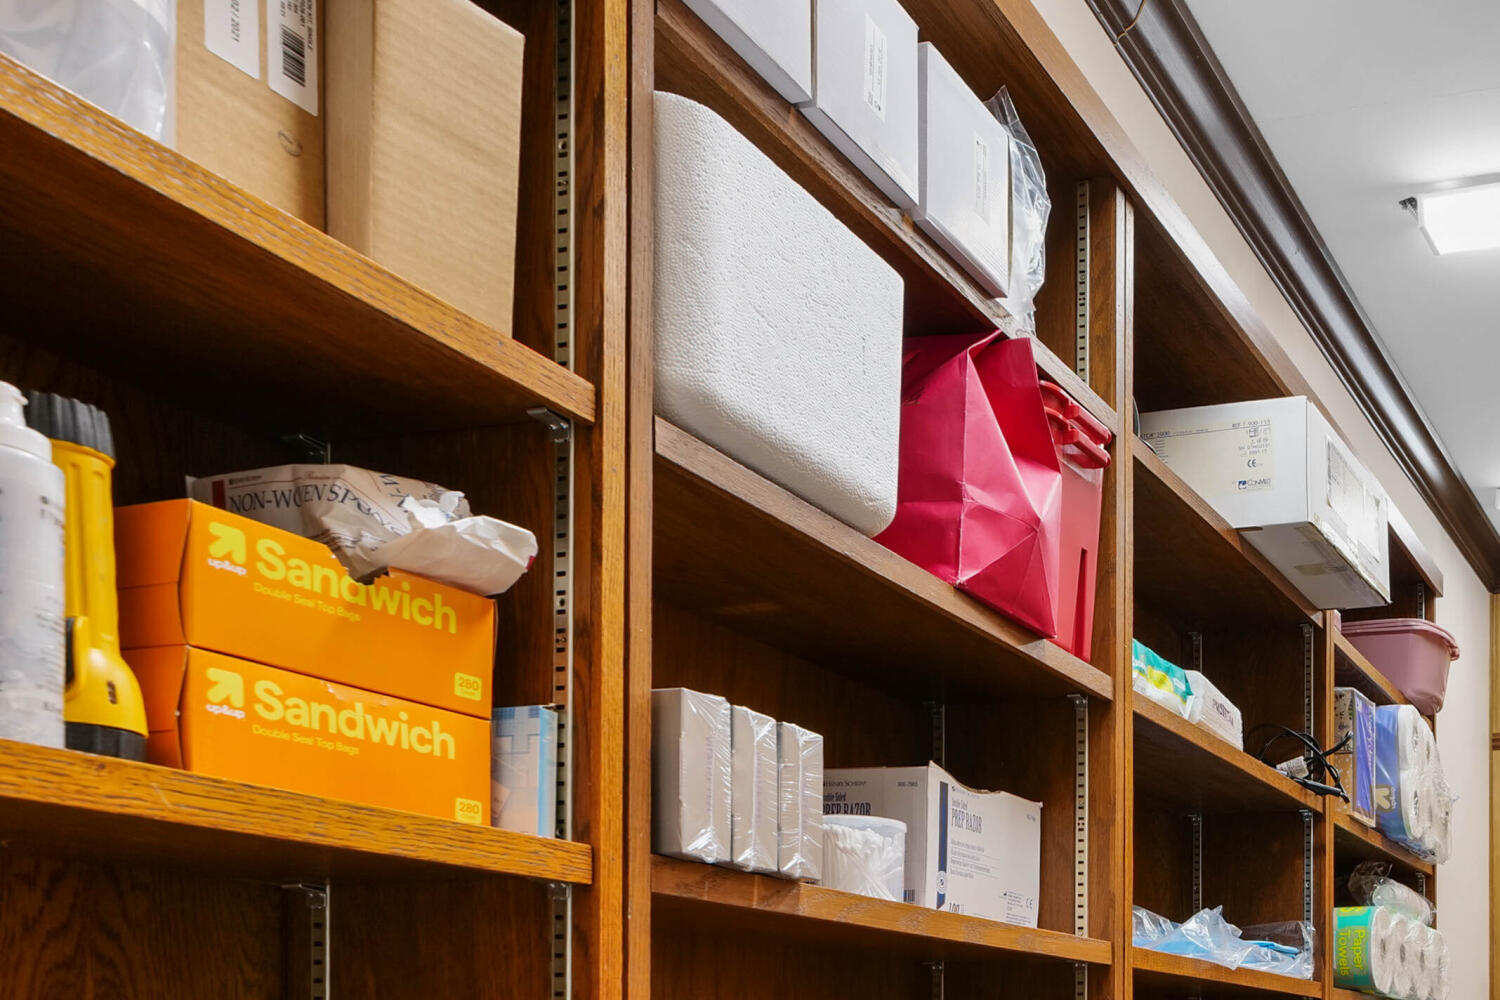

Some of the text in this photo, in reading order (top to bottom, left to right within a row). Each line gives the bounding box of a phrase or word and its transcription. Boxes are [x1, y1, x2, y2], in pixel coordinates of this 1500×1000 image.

[229, 484, 325, 512] NON-WOEN
[253, 582, 292, 602] Double
[317, 599, 336, 616] Top
[256, 538, 457, 634] Sandwich
[458, 676, 479, 691] 280
[254, 679, 456, 760] Sandwich
[252, 724, 360, 756] Double Seal Top Bags
[459, 801, 480, 815] 280
[951, 808, 982, 834] PREP RAZOR
[1338, 929, 1351, 976] Towels
[1352, 929, 1366, 971] Paper
